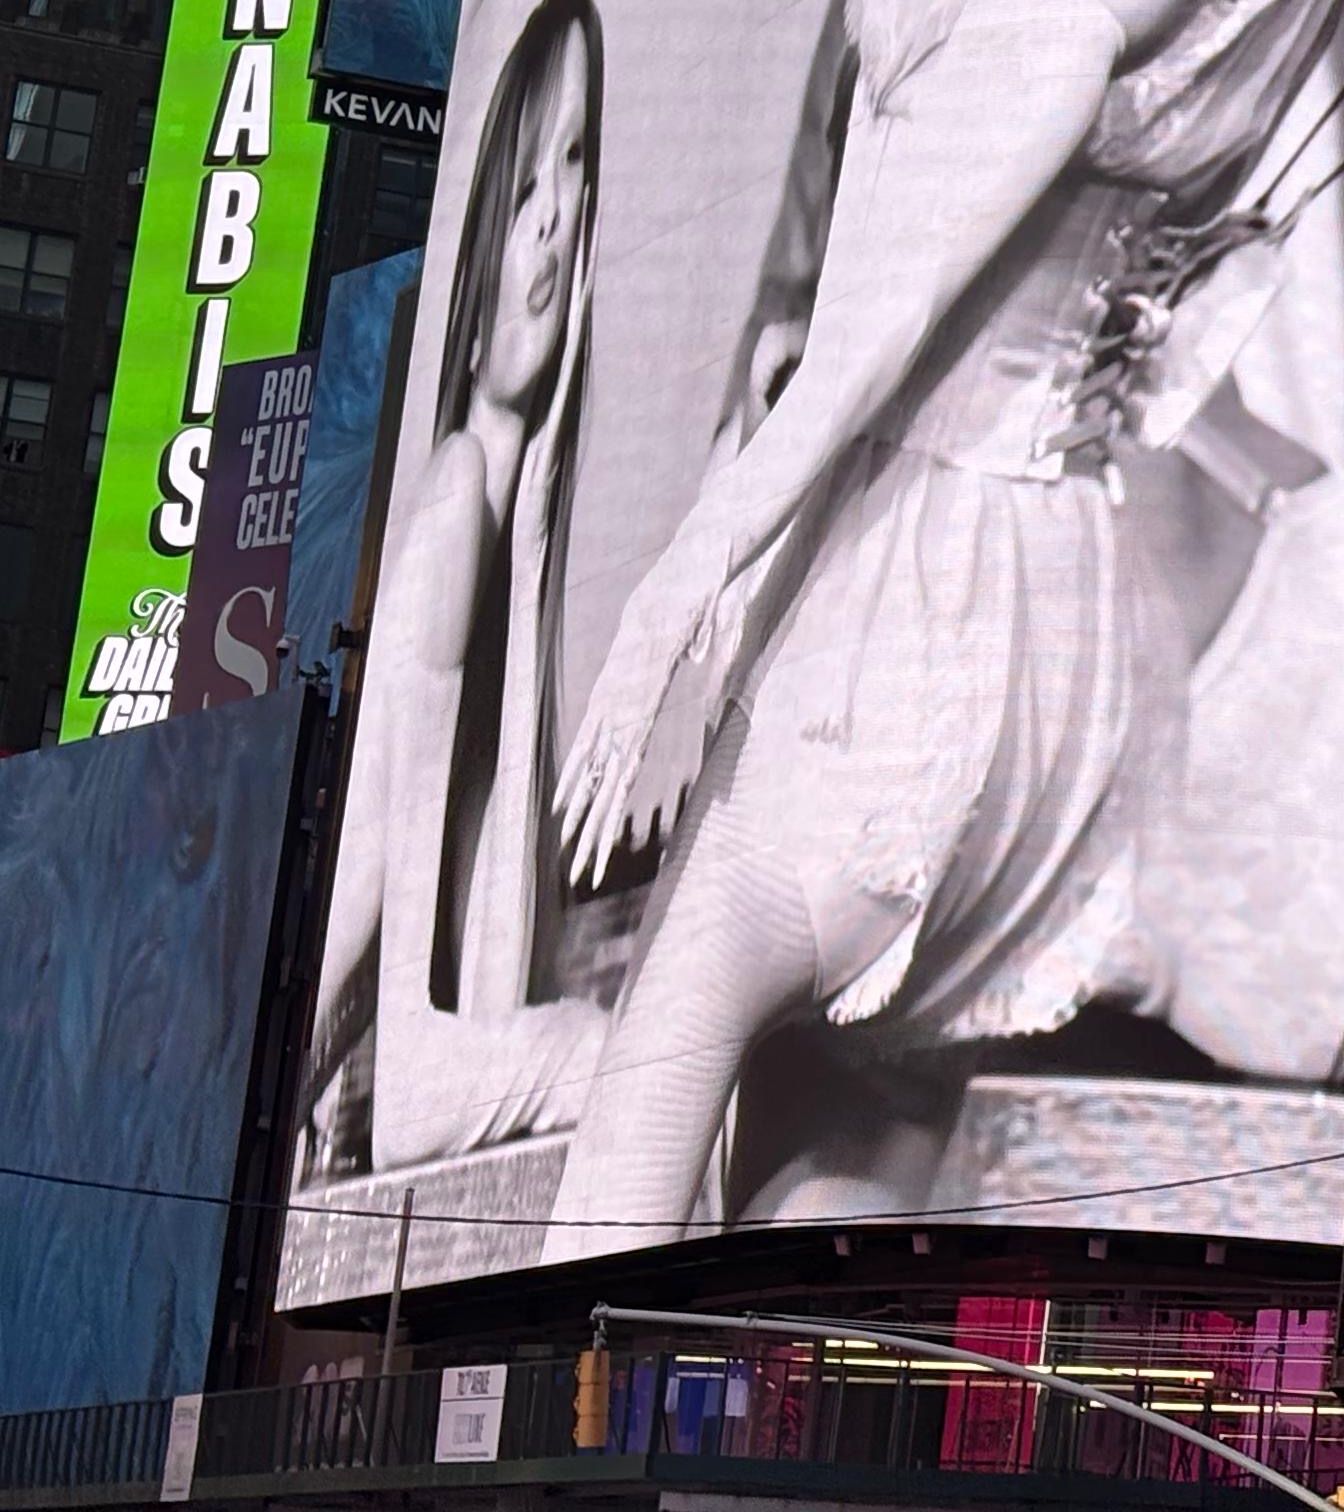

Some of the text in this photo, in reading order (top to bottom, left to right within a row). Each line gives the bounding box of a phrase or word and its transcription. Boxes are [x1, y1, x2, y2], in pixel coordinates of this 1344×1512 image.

[323, 88, 442, 135] KEVAN
[258, 364, 313, 421] BRO
[236, 488, 299, 550] CELE
[131, 588, 187, 647] Th
[214, 586, 275, 696] S
[88, 636, 179, 692] DAIL
